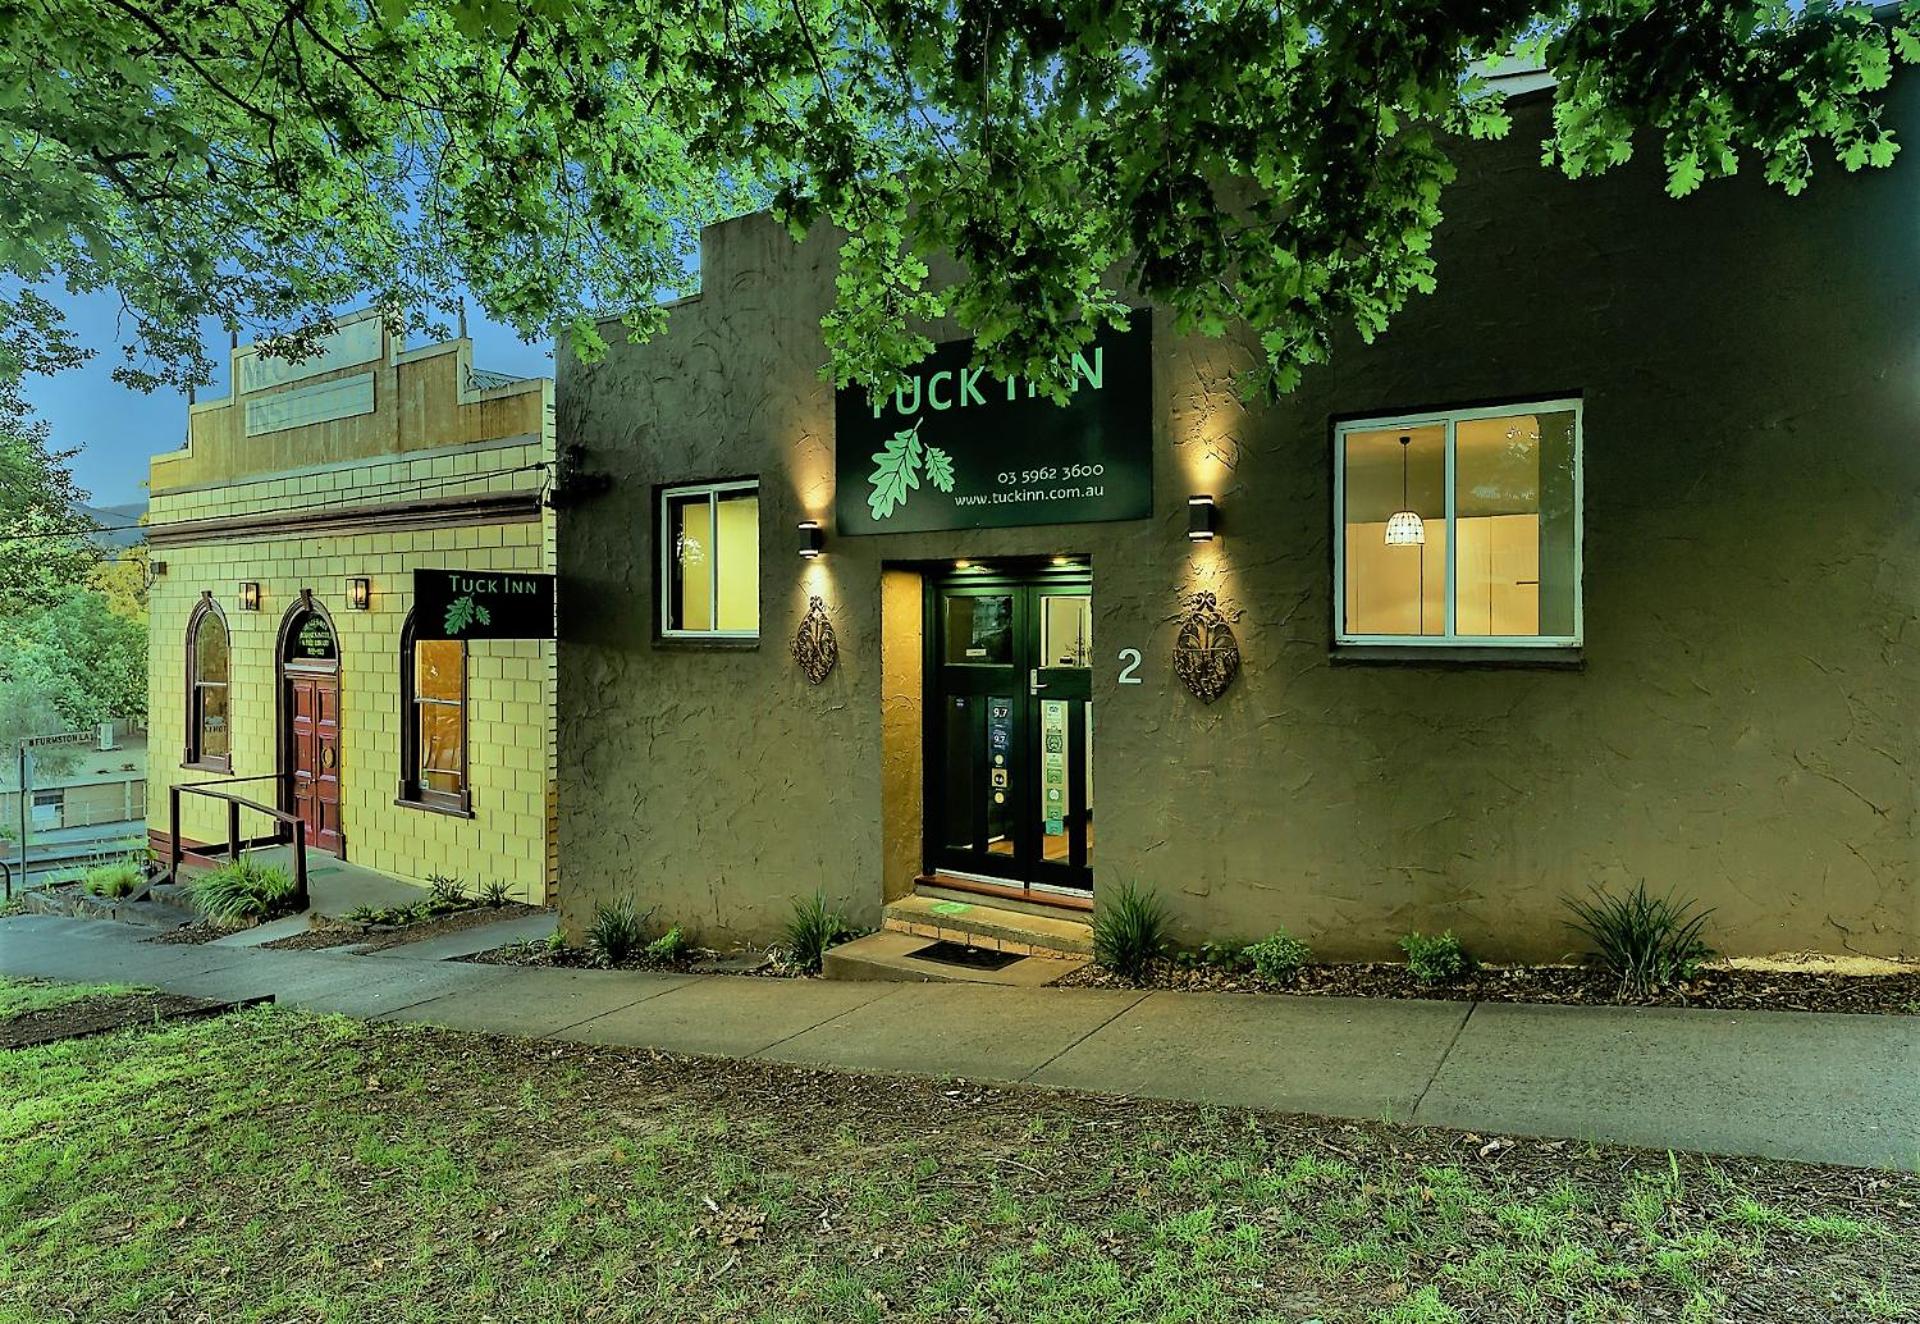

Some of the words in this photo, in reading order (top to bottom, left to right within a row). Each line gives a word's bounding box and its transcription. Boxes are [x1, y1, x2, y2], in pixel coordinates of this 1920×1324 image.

[997, 472, 1017, 485] 03
[1022, 467, 1057, 482] 5962
[1061, 464, 1104, 480] 3600
[954, 484, 1104, 506] www.tuckinn.com.au
[1118, 647, 1142, 684] 2
